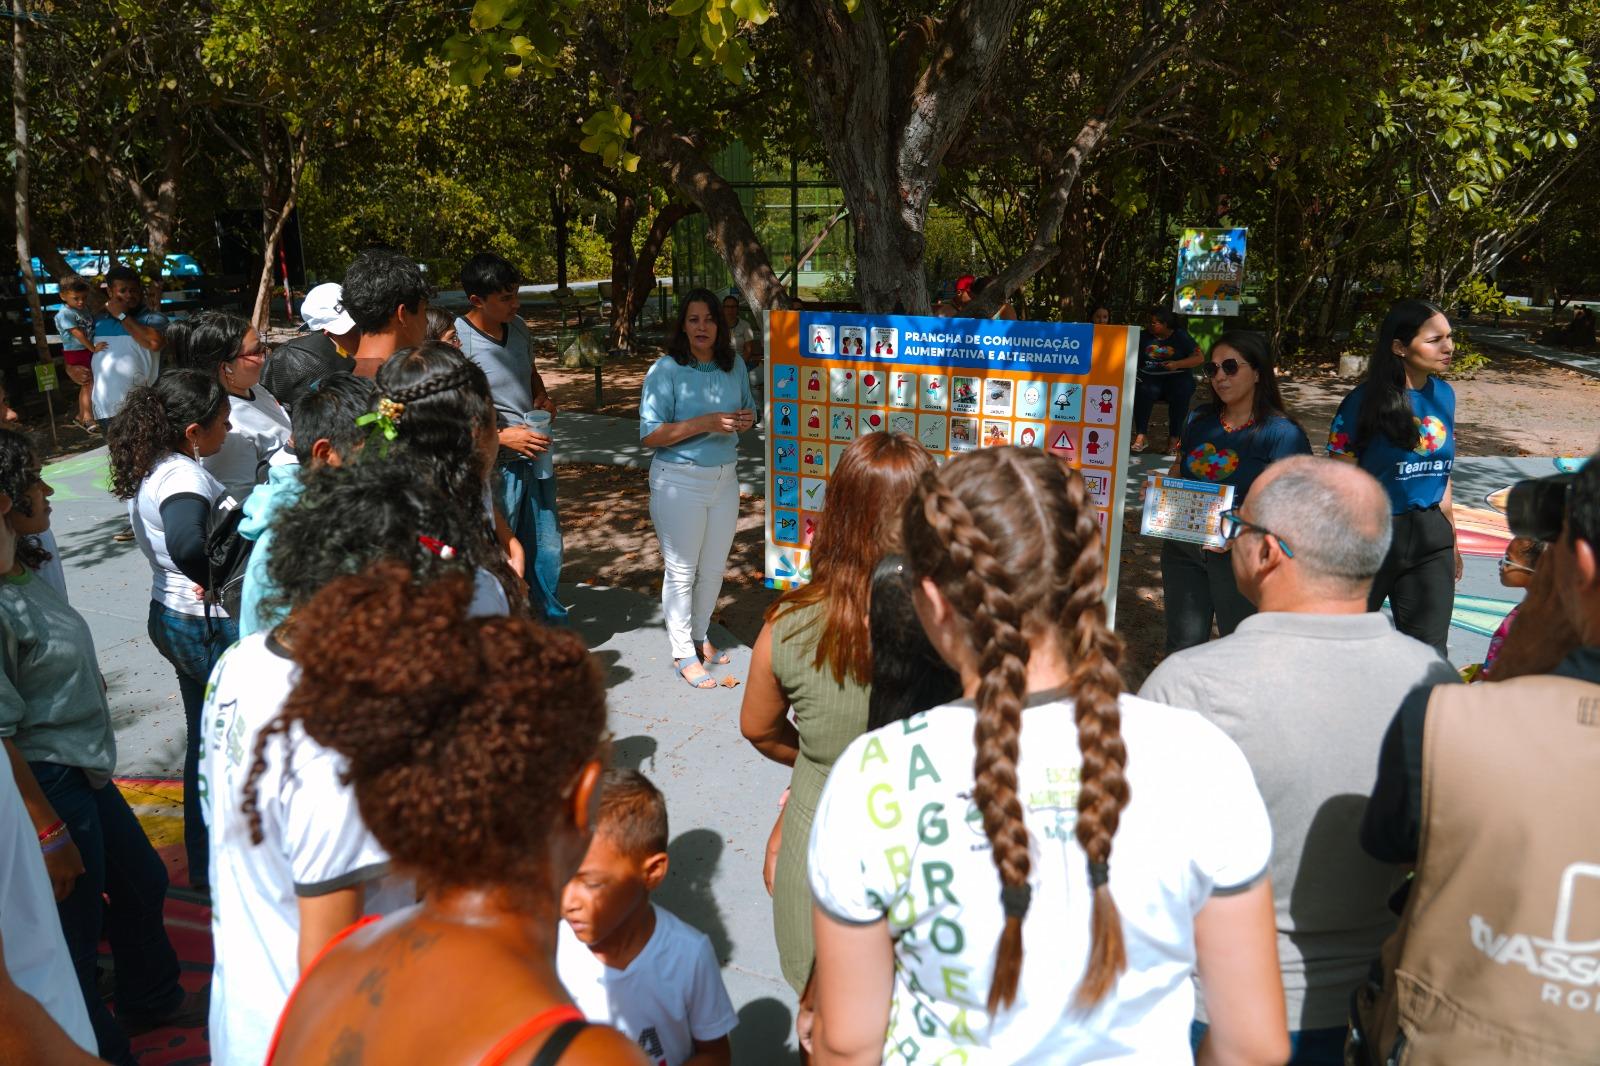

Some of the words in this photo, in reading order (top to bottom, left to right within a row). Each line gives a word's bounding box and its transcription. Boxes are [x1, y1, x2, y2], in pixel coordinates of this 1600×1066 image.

[1182, 261, 1239, 273] ANIMAIS
[1182, 272, 1238, 281] SILVESTRES
[904, 331, 962, 344] PRANCHA
[965, 335, 980, 345] DE
[983, 335, 1081, 352] COMUNICAÇÃO
[904, 346, 986, 360] AUMENTATIVA
[988, 351, 995, 360] E
[997, 351, 1081, 366] ALTERNATIVA
[1541, 982, 1600, 1015] RO
